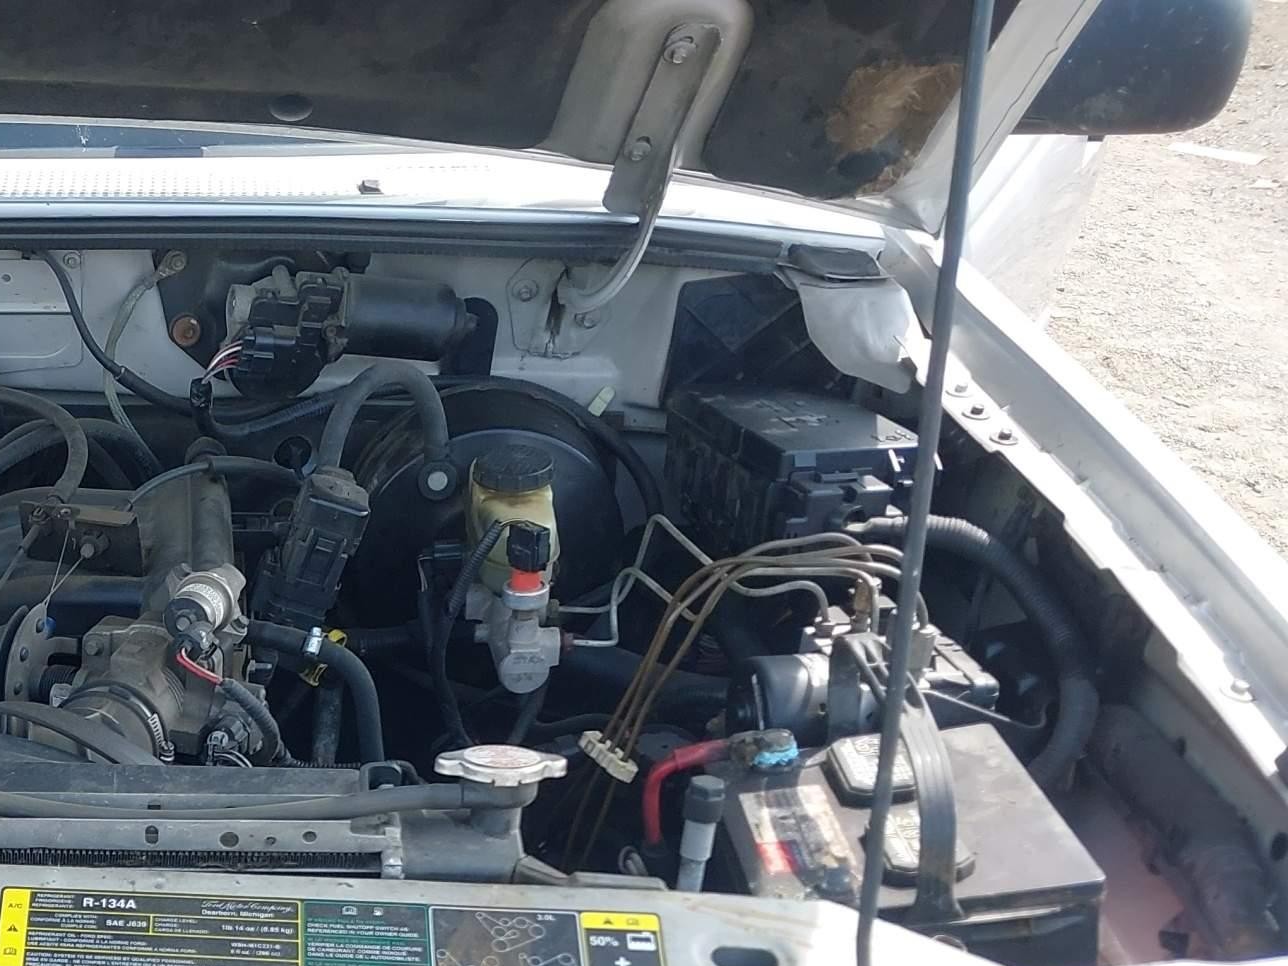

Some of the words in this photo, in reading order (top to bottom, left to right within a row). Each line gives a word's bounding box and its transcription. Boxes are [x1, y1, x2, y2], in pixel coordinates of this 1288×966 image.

[82, 896, 137, 909] R-134A
[200, 900, 222, 910] Ford
[221, 901, 248, 911] Motor
[239, 910, 274, 918] Michigan
[589, 936, 620, 946] 50%
